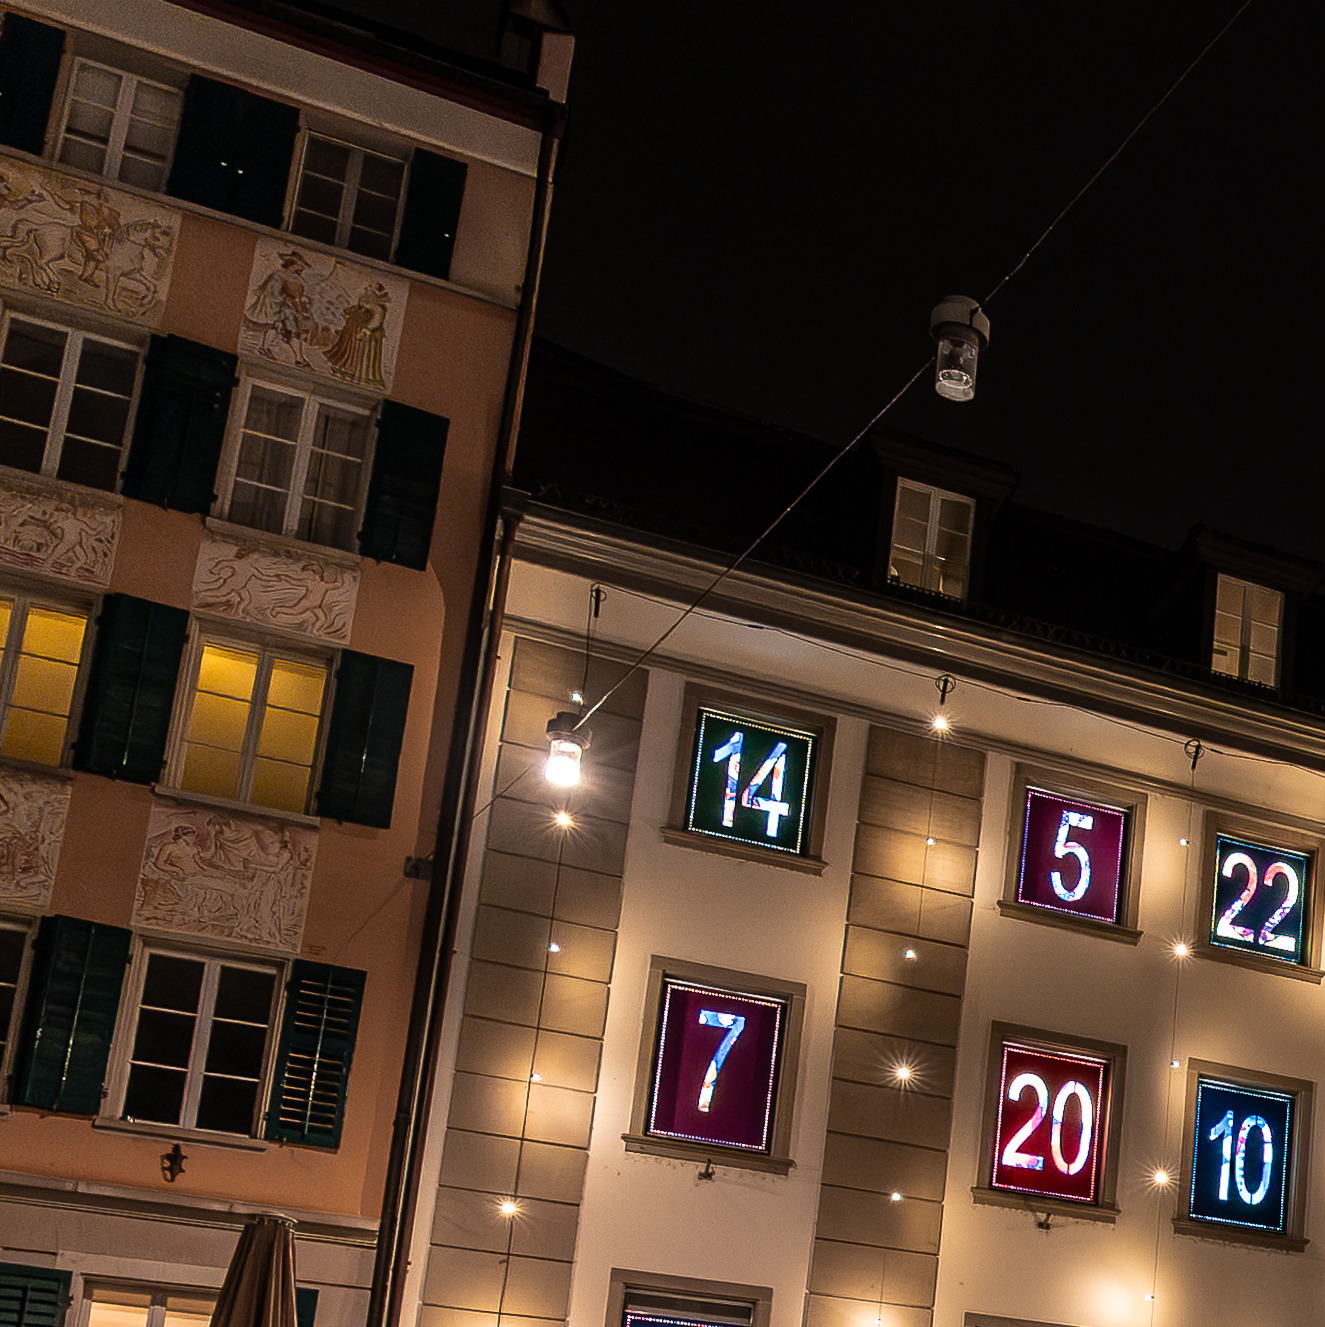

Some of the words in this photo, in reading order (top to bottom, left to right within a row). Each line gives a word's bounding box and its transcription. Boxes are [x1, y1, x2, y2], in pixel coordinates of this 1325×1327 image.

[713, 731, 789, 838] 14
[1051, 810, 1093, 901] 5
[1216, 851, 1299, 954] 22
[698, 1010, 745, 1112] 7
[1007, 1072, 1093, 1176] 20
[1209, 1110, 1273, 1205] 10
